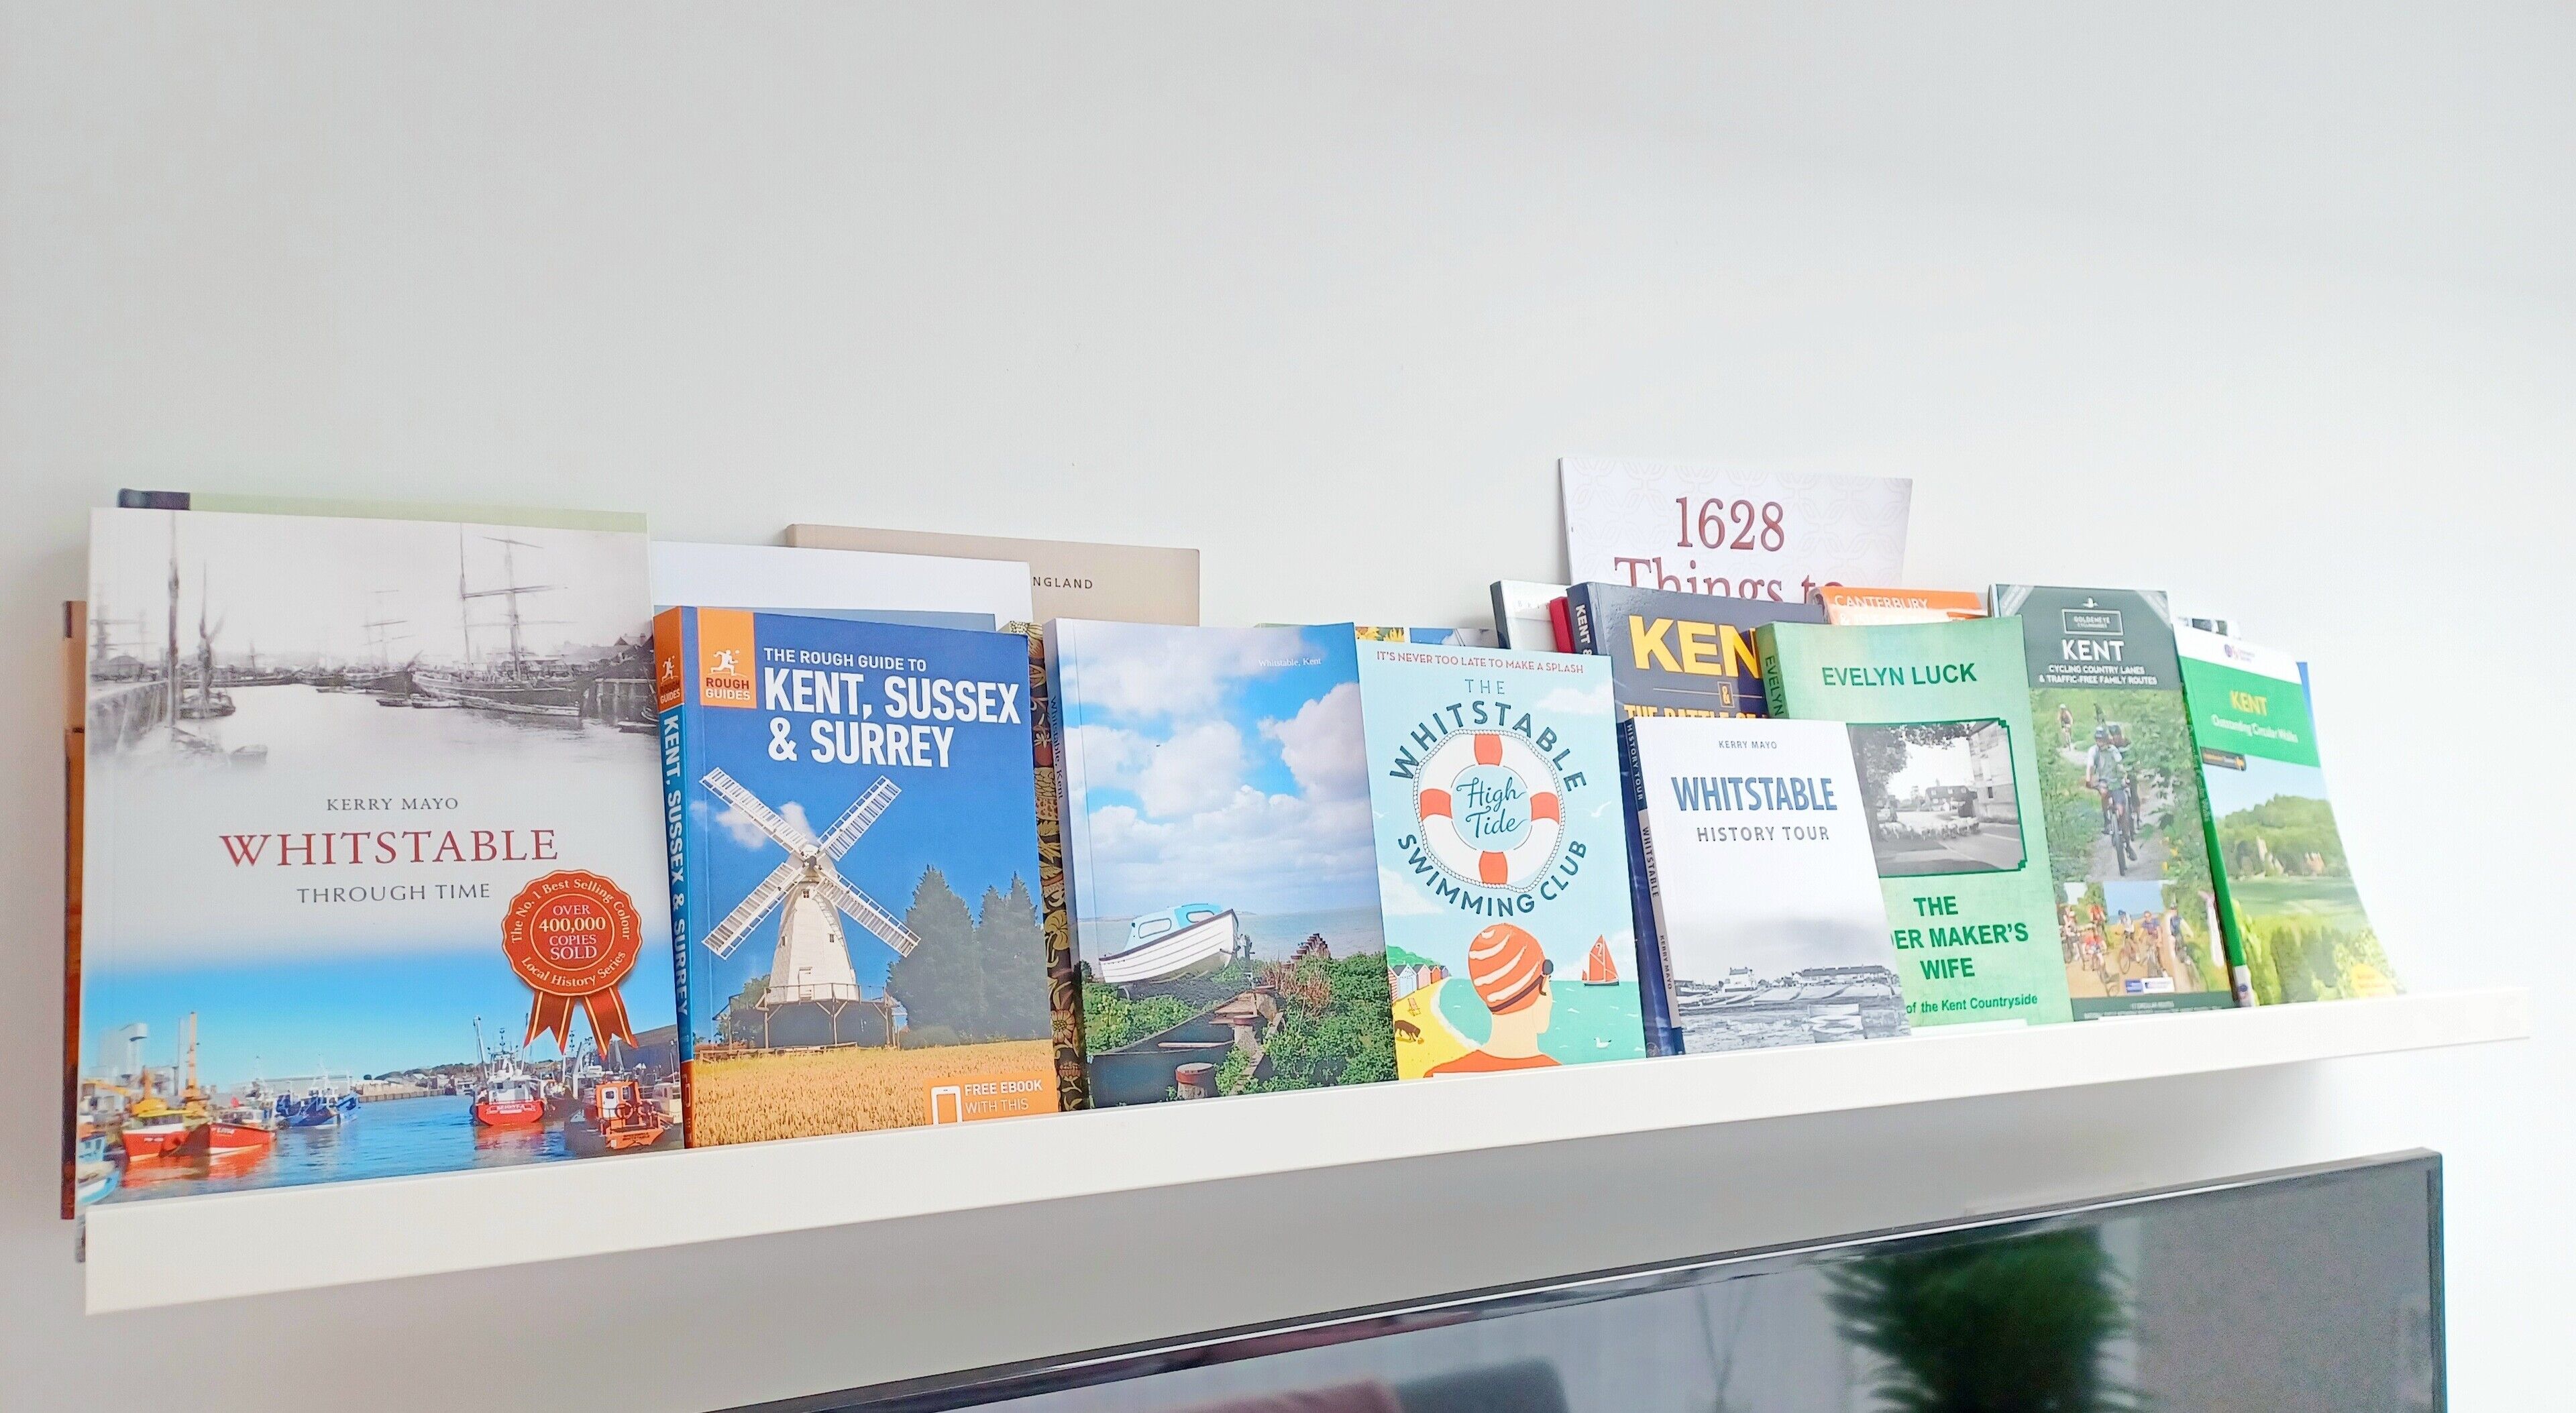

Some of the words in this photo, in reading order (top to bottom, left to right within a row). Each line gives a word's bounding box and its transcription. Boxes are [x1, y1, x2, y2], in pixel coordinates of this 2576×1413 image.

[1676, 496, 1784, 552] 1628
[1033, 577, 1093, 589] NGLAND
[1835, 595, 1928, 610] CANTERBURY
[1575, 604, 1591, 644] KENT
[1629, 614, 1762, 679] KEN
[2062, 639, 2125, 662] KENT
[763, 648, 796, 663] THE
[800, 651, 854, 667] ROUGH
[857, 655, 904, 671] GUIDE
[908, 658, 927, 672] TO
[1258, 659, 1301, 667] Whitstable,
[1303, 657, 1322, 666] Kent
[1377, 651, 1395, 661] IT'S
[1398, 653, 1433, 664] NEVER
[1435, 655, 1458, 666] TOO
[1461, 657, 1487, 667] LATE
[1489, 658, 1503, 668] TO
[1505, 660, 1535, 671] MAKE
[1537, 662, 1544, 671] A
[1546, 663, 1584, 673] SPLASH
[2049, 665, 2081, 674] CYCLING
[2083, 665, 2118, 675] COUNTRY
[706, 677, 749, 689] ROUGH
[1822, 667, 1904, 686] EVELYN
[1912, 663, 1978, 685] LUCK
[2100, 676, 2127, 684] FAMILY
[659, 688, 680, 704] GUIDES
[705, 688, 751, 701] GUIDES
[763, 667, 873, 721] KENT,
[884, 676, 1022, 725] SUSSEX
[1464, 679, 1505, 695] THE
[1721, 685, 1731, 705] &
[1765, 655, 1784, 718] EVELYN
[2230, 690, 2267, 716] KENT
[663, 715, 680, 785] KENT,
[767, 717, 798, 762] &
[810, 718, 955, 769] SURREY
[1389, 700, 1587, 792] WHITSTABLE
[1719, 740, 1747, 749] KERRY
[1752, 741, 1777, 749] MAYO
[1627, 724, 1639, 769] HISTORY
[1634, 773, 1644, 801] TOUR
[327, 798, 392, 811] KERRY
[402, 797, 460, 810] MAYO
[1456, 777, 1527, 813] High
[1670, 777, 1837, 811] WHITSTABLE
[1465, 808, 1533, 839] Tide
[1697, 826, 1774, 842] HISTORY
[1782, 826, 1829, 840] TOUR
[667, 789, 685, 884] SUSSEX
[219, 829, 559, 868] WHITSTABLE
[1643, 827, 1660, 897] WHITSTABLE
[541, 879, 570, 894] Best
[1397, 834, 1535, 917] SWIMMING
[1540, 840, 1587, 901] CLUB
[297, 885, 426, 904] THROUGH
[435, 883, 491, 899] TIME
[574, 879, 614, 903] Selling
[672, 893, 685, 911] &
[516, 901, 535, 917] No.
[553, 905, 591, 915] OVER
[1913, 895, 1959, 917] THE
[511, 919, 523, 943] The
[539, 917, 606, 934] 400,000
[613, 901, 630, 940] Colour
[549, 935, 596, 946] COPIES
[1890, 929, 1925, 950] ER
[1929, 922, 2029, 948] MAKER'S
[550, 946, 597, 960] SOLD
[1660, 935, 1668, 962] KERRY
[521, 956, 551, 981] Local
[550, 974, 596, 986] History
[598, 951, 627, 979] Series
[673, 918, 688, 1016] SURREY
[1919, 957, 1976, 980] WIFE
[1907, 1001, 1917, 1014] of
[1921, 1001, 1938, 1013] the
[1941, 999, 1966, 1011] Kent
[1970, 994, 2038, 1009] Countryside
[964, 1082, 998, 1096] FREE
[1000, 1079, 1043, 1094] EBOOK
[965, 1100, 998, 1114] WITH
[1000, 1098, 1029, 1111] THIS
